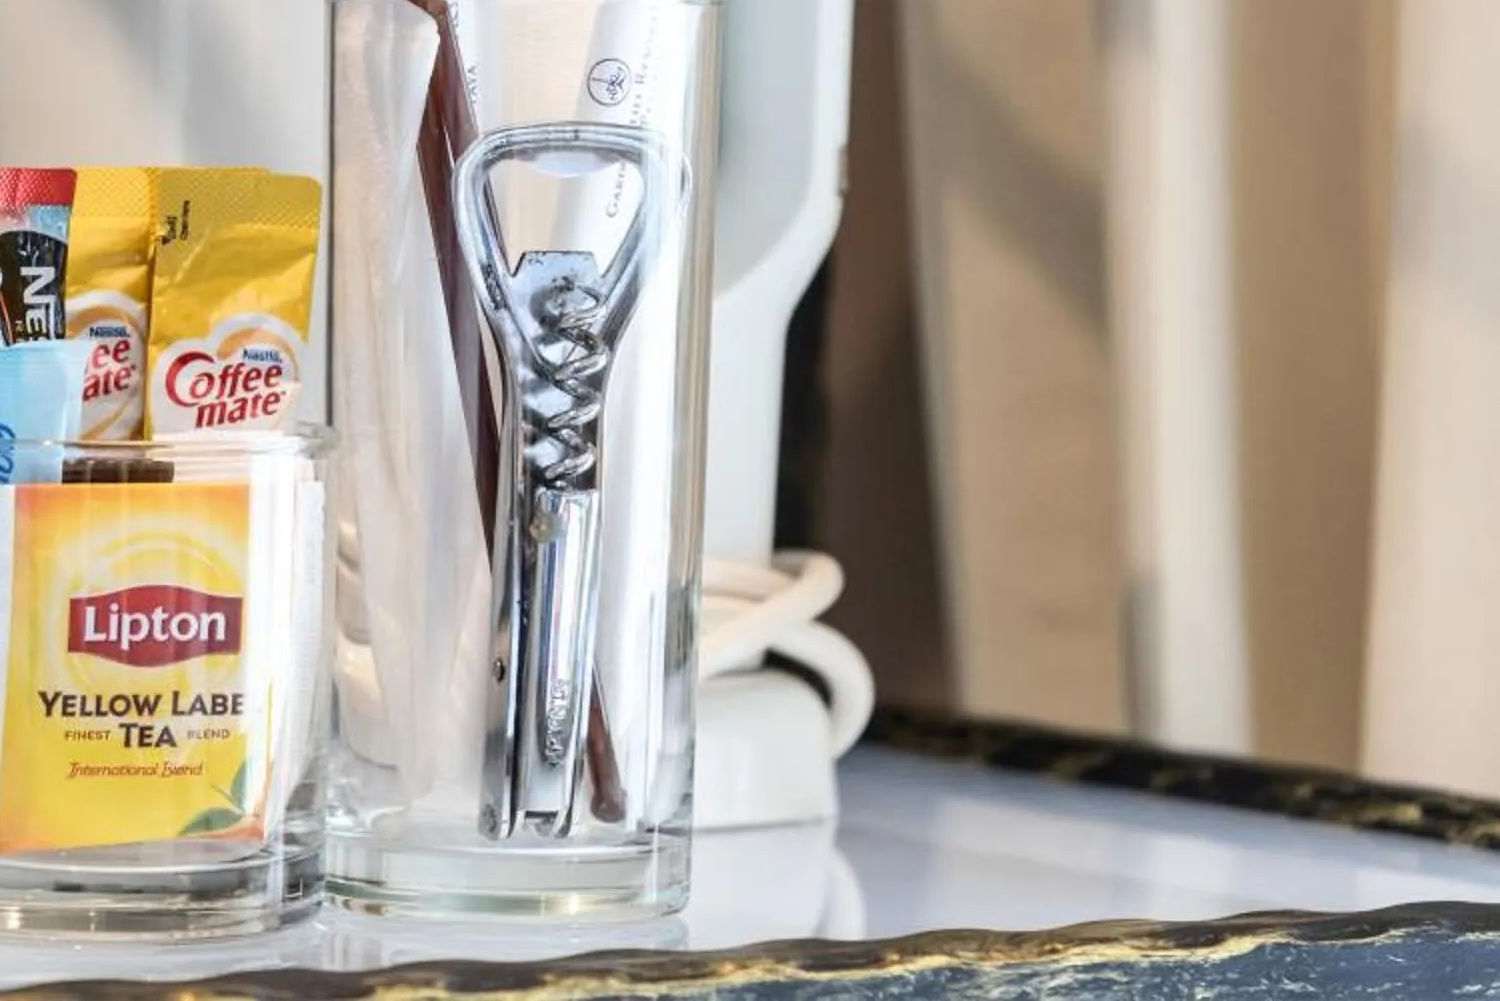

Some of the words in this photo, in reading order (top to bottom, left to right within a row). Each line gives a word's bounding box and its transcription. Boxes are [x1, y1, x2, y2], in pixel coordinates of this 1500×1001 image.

[92, 339, 131, 369] ee
[82, 366, 132, 401] ate
[165, 351, 283, 407] Coffee
[195, 390, 282, 429] mate
[84, 603, 226, 651] Lipton
[38, 690, 162, 718] YELLOW
[171, 690, 244, 716] LABE
[65, 729, 111, 741] FINEST
[119, 723, 178, 748] TEA
[187, 728, 231, 740] BLEND
